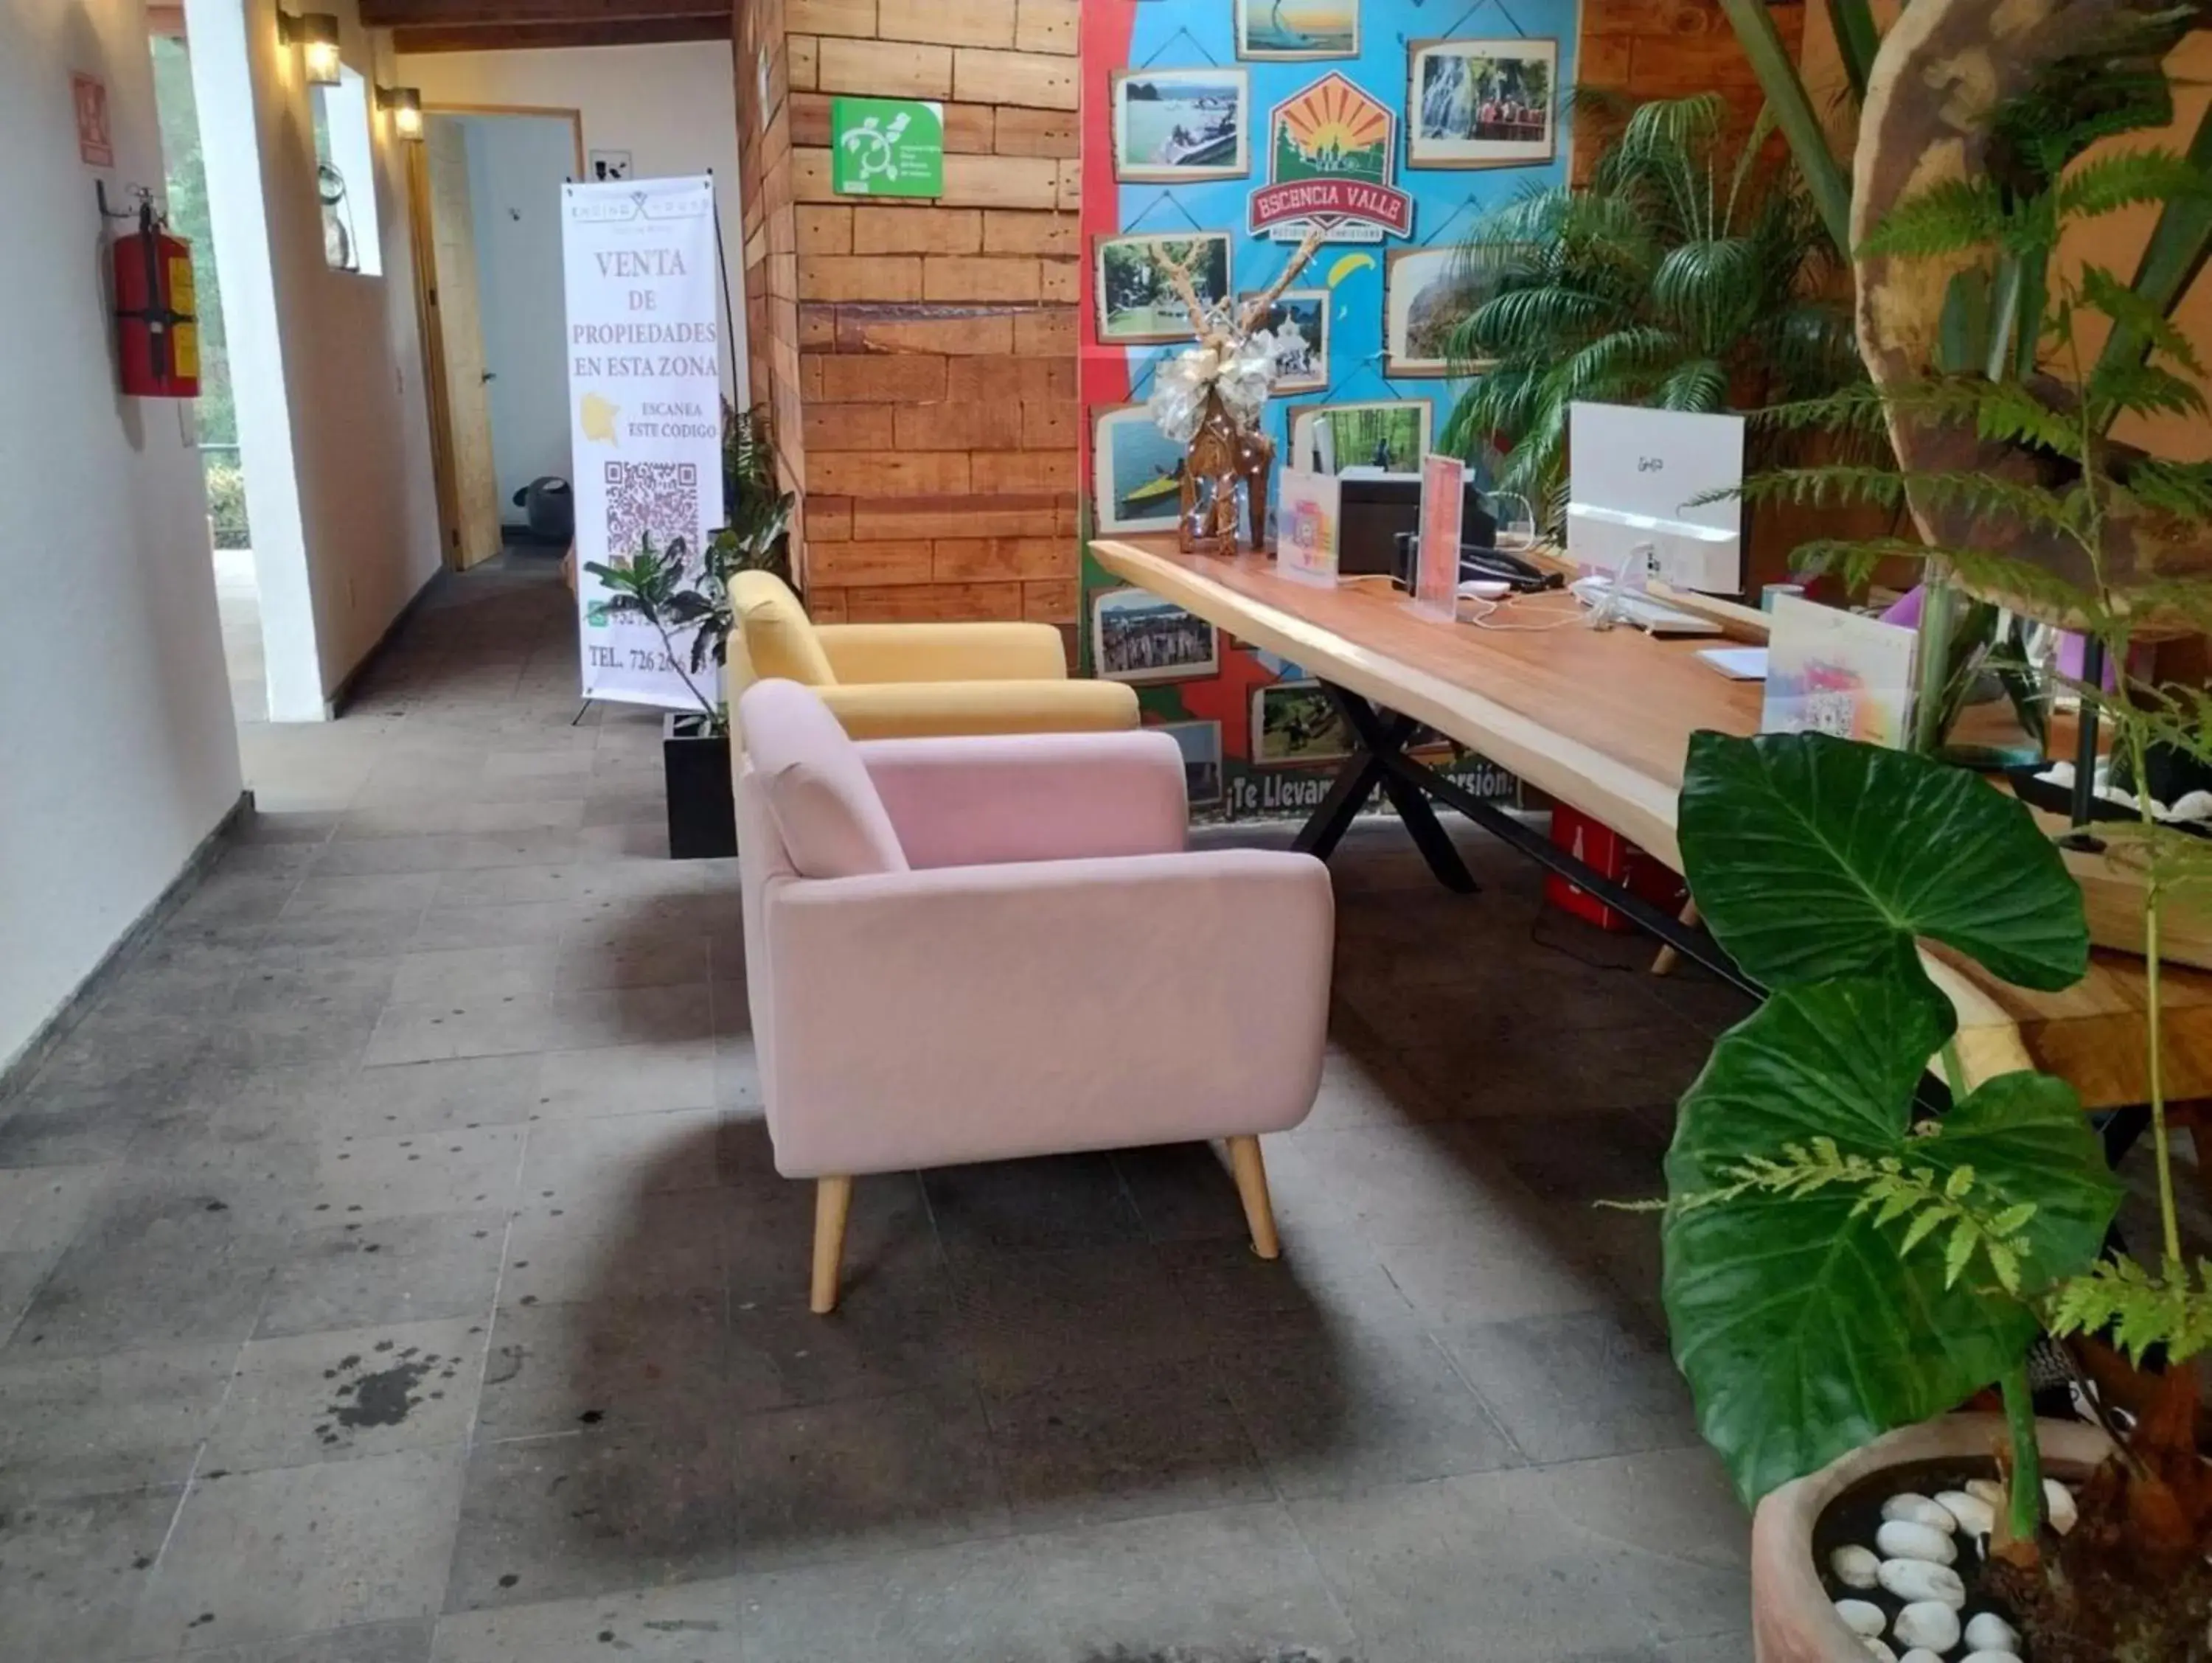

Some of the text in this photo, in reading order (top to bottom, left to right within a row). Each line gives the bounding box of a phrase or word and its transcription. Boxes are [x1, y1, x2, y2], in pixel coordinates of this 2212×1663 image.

[1346, 186, 1402, 220] VALLE
[594, 248, 686, 279] VENTA
[628, 290, 657, 311] DE
[572, 322, 717, 344] PROPIEDADES
[574, 356, 719, 377] EN ESTA ZONA
[642, 402, 703, 417] ESCANEA
[628, 422, 664, 438] ESTE
[590, 645, 623, 668] TEL.
[630, 649, 655, 672] 726
